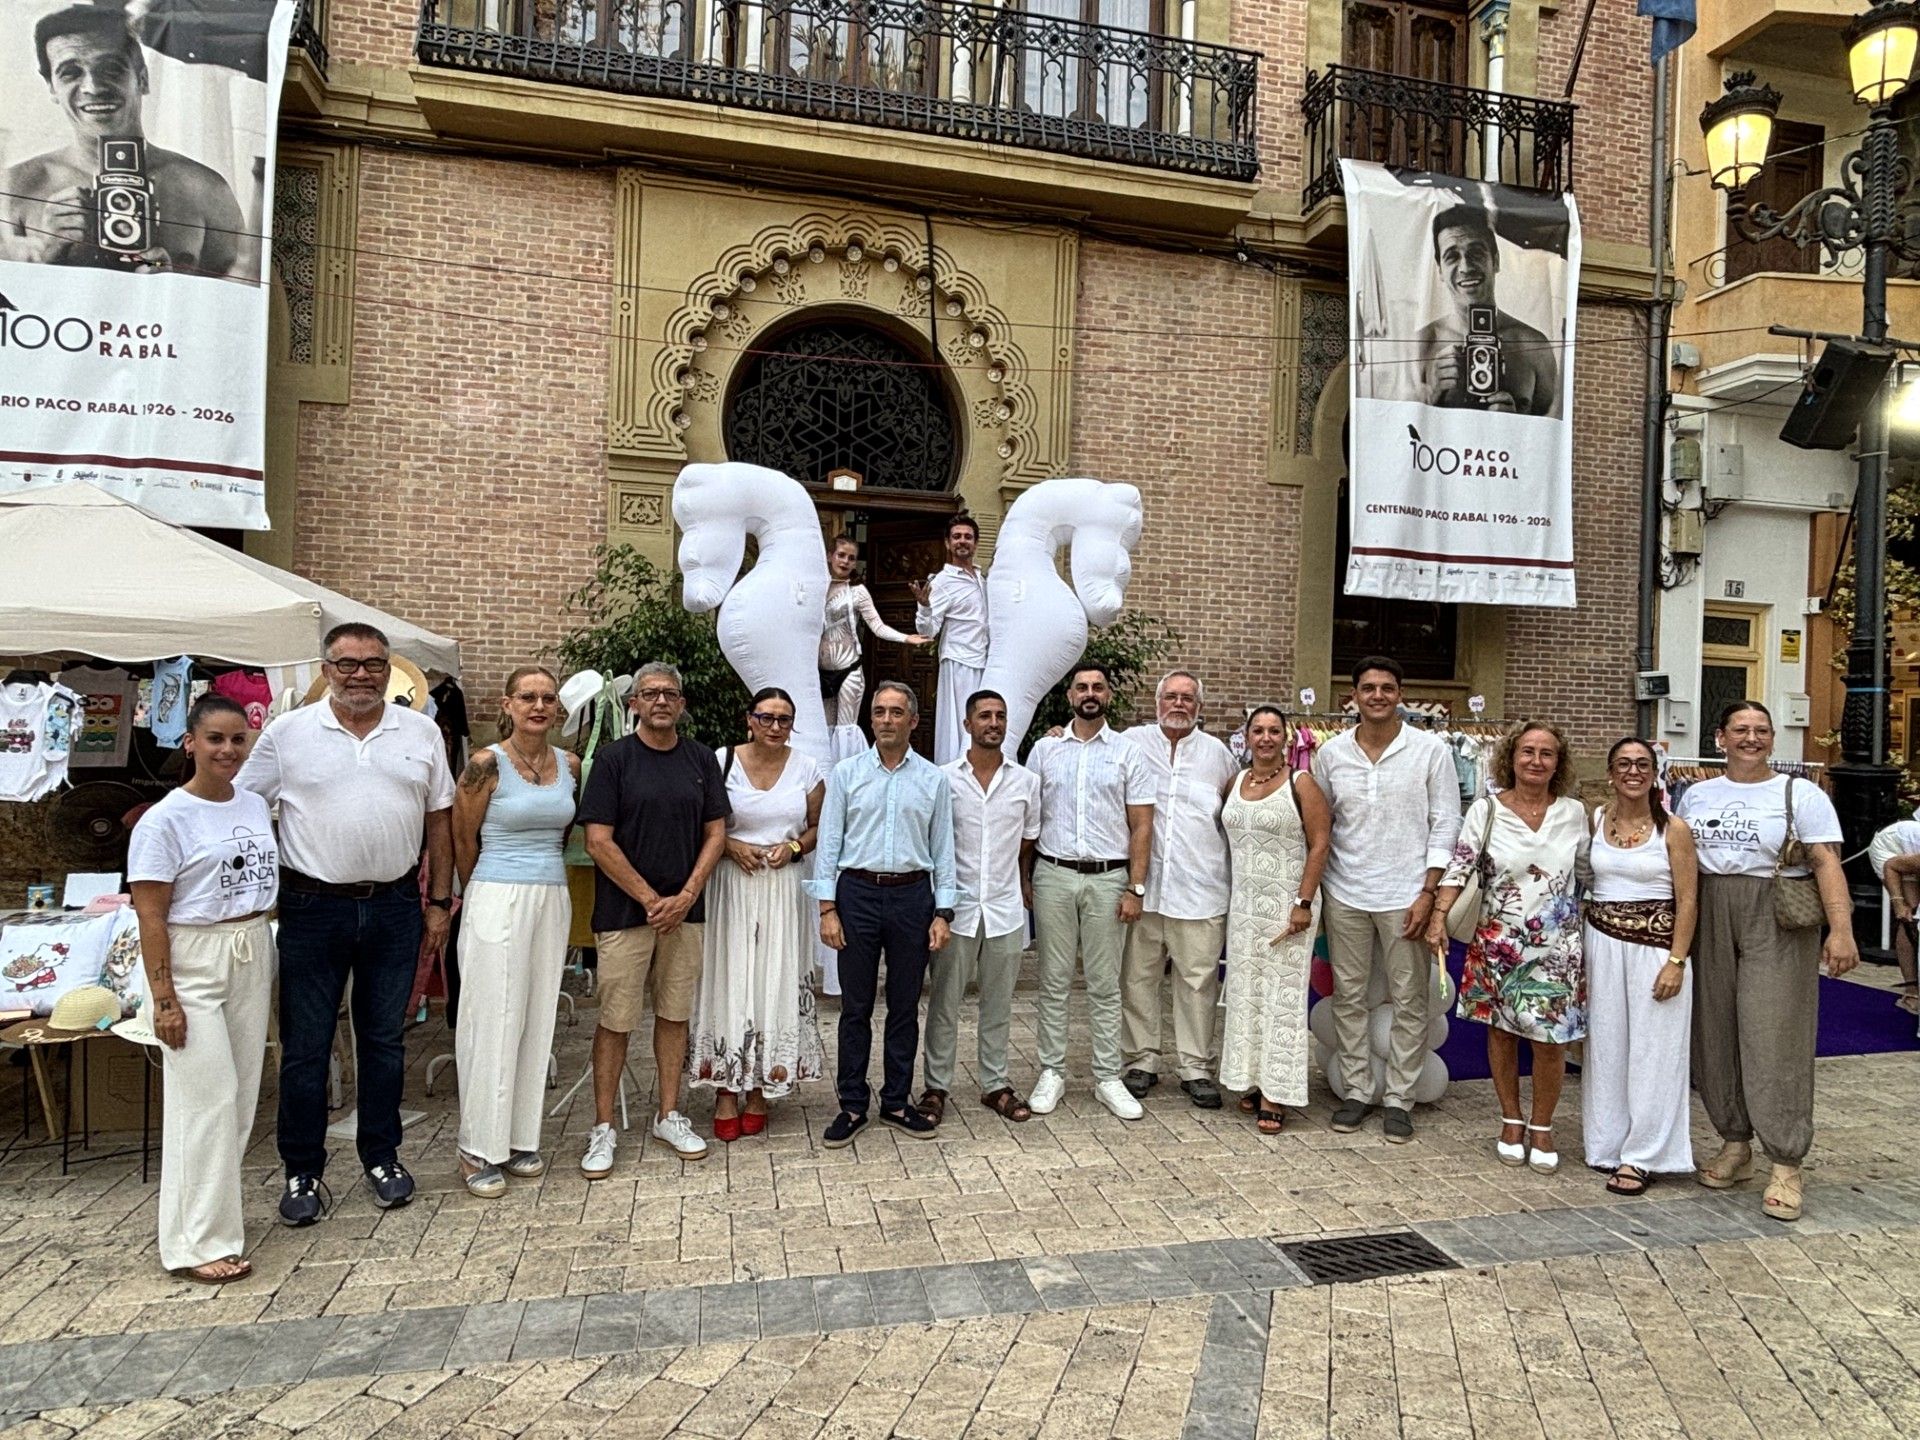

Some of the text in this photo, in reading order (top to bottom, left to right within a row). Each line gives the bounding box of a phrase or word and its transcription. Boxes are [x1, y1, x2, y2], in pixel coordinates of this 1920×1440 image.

[99, 320, 163, 339] PACO
[99, 341, 178, 359] RABAL
[0, 395, 30, 408] RIO
[35, 397, 82, 412] PACO
[87, 402, 138, 416] RABAL
[142, 403, 176, 417] 1926
[193, 407, 235, 424] 2026
[1409, 440, 1460, 476] 100
[1464, 448, 1510, 463] PACO
[1463, 464, 1519, 480] RABAL
[1366, 503, 1423, 518] CENTENARIO
[1425, 510, 1449, 522] PACO
[1452, 511, 1488, 523] RABAL
[1492, 513, 1518, 524] 1926
[1527, 515, 1551, 527] 2026
[1727, 582, 1741, 595] 15
[1720, 810, 1739, 819] LA
[1691, 828, 1760, 845] BLANCA
[237, 839, 258, 853] LA
